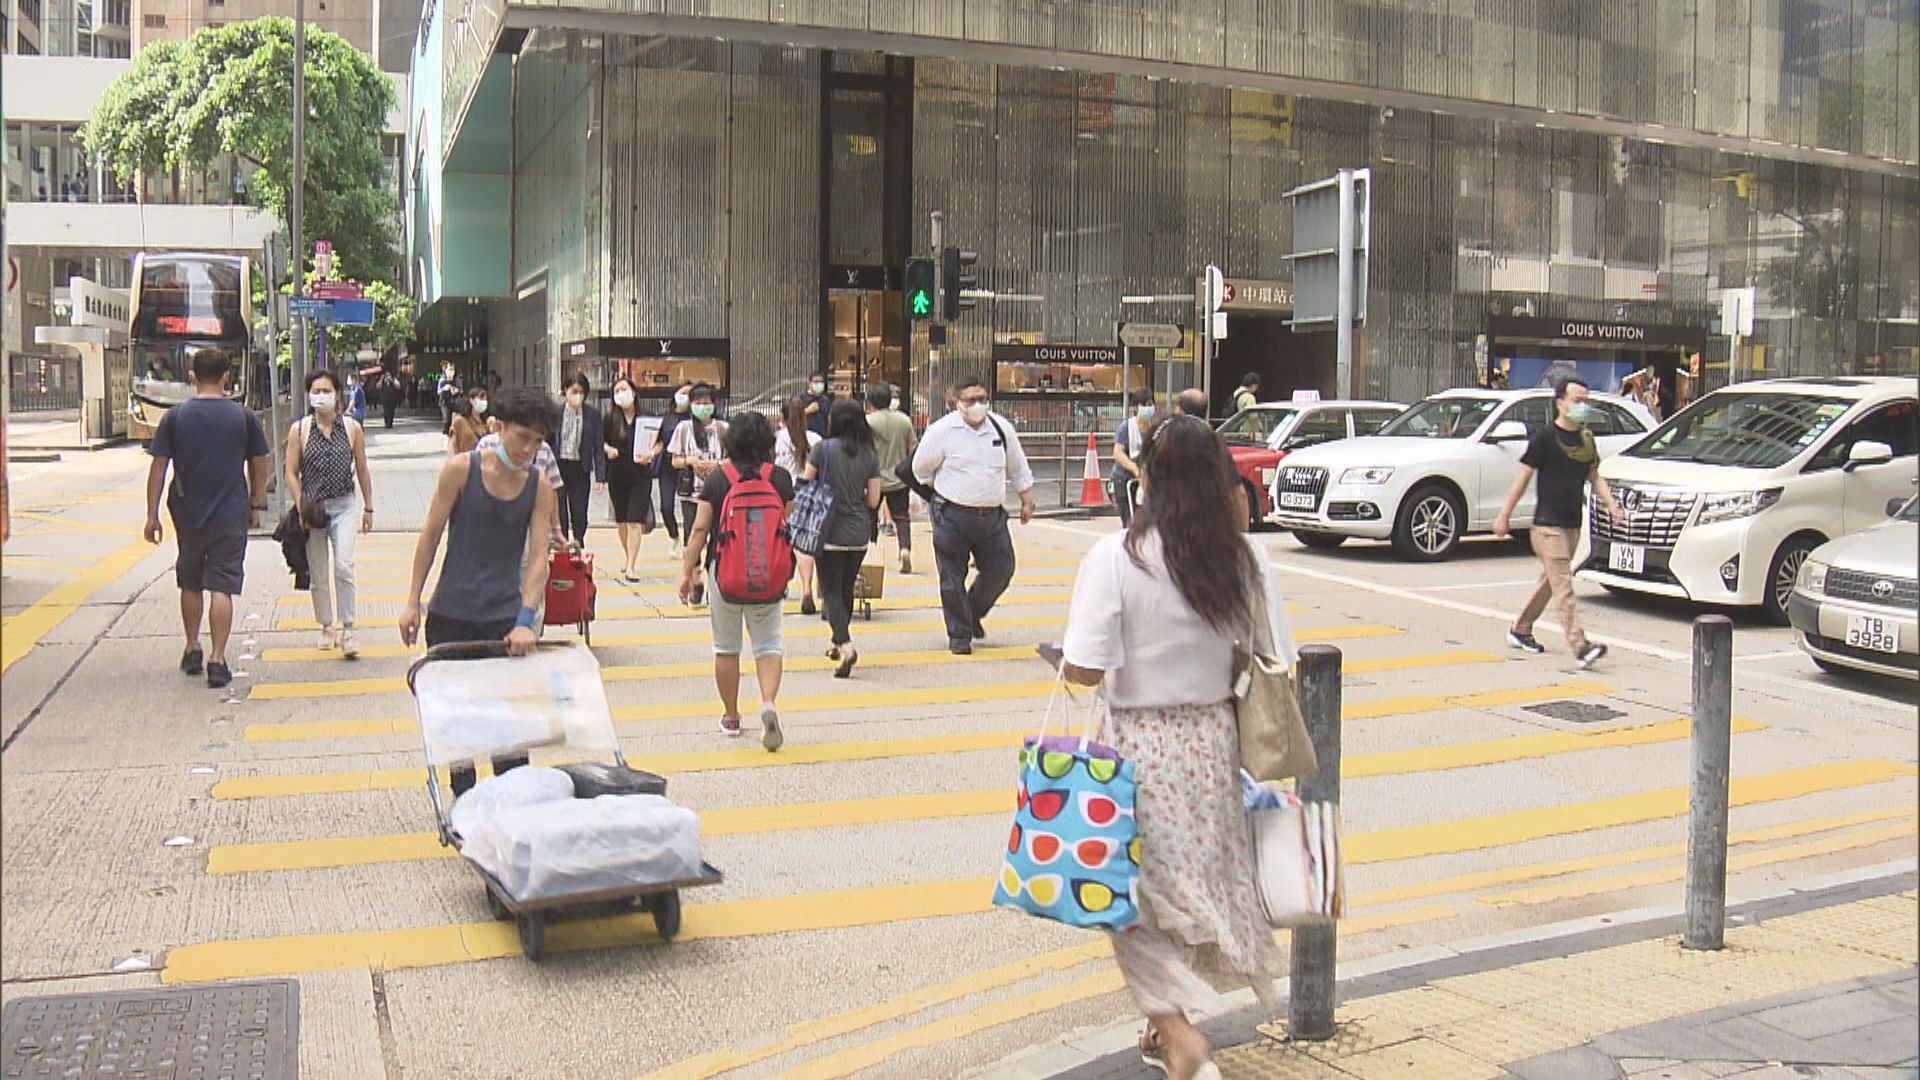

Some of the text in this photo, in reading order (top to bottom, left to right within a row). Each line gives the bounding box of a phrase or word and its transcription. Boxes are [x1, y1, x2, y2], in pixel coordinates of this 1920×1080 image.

[1242, 286, 1287, 304] 中環站
[1561, 322, 1644, 339] LOUIS VUITTON
[1035, 348, 1116, 361] LOUIS VUITTON
[1620, 546, 1635, 558] VN
[1617, 558, 1635, 570] 184
[1863, 616, 1883, 633] TB
[1850, 630, 1894, 651] 3928
